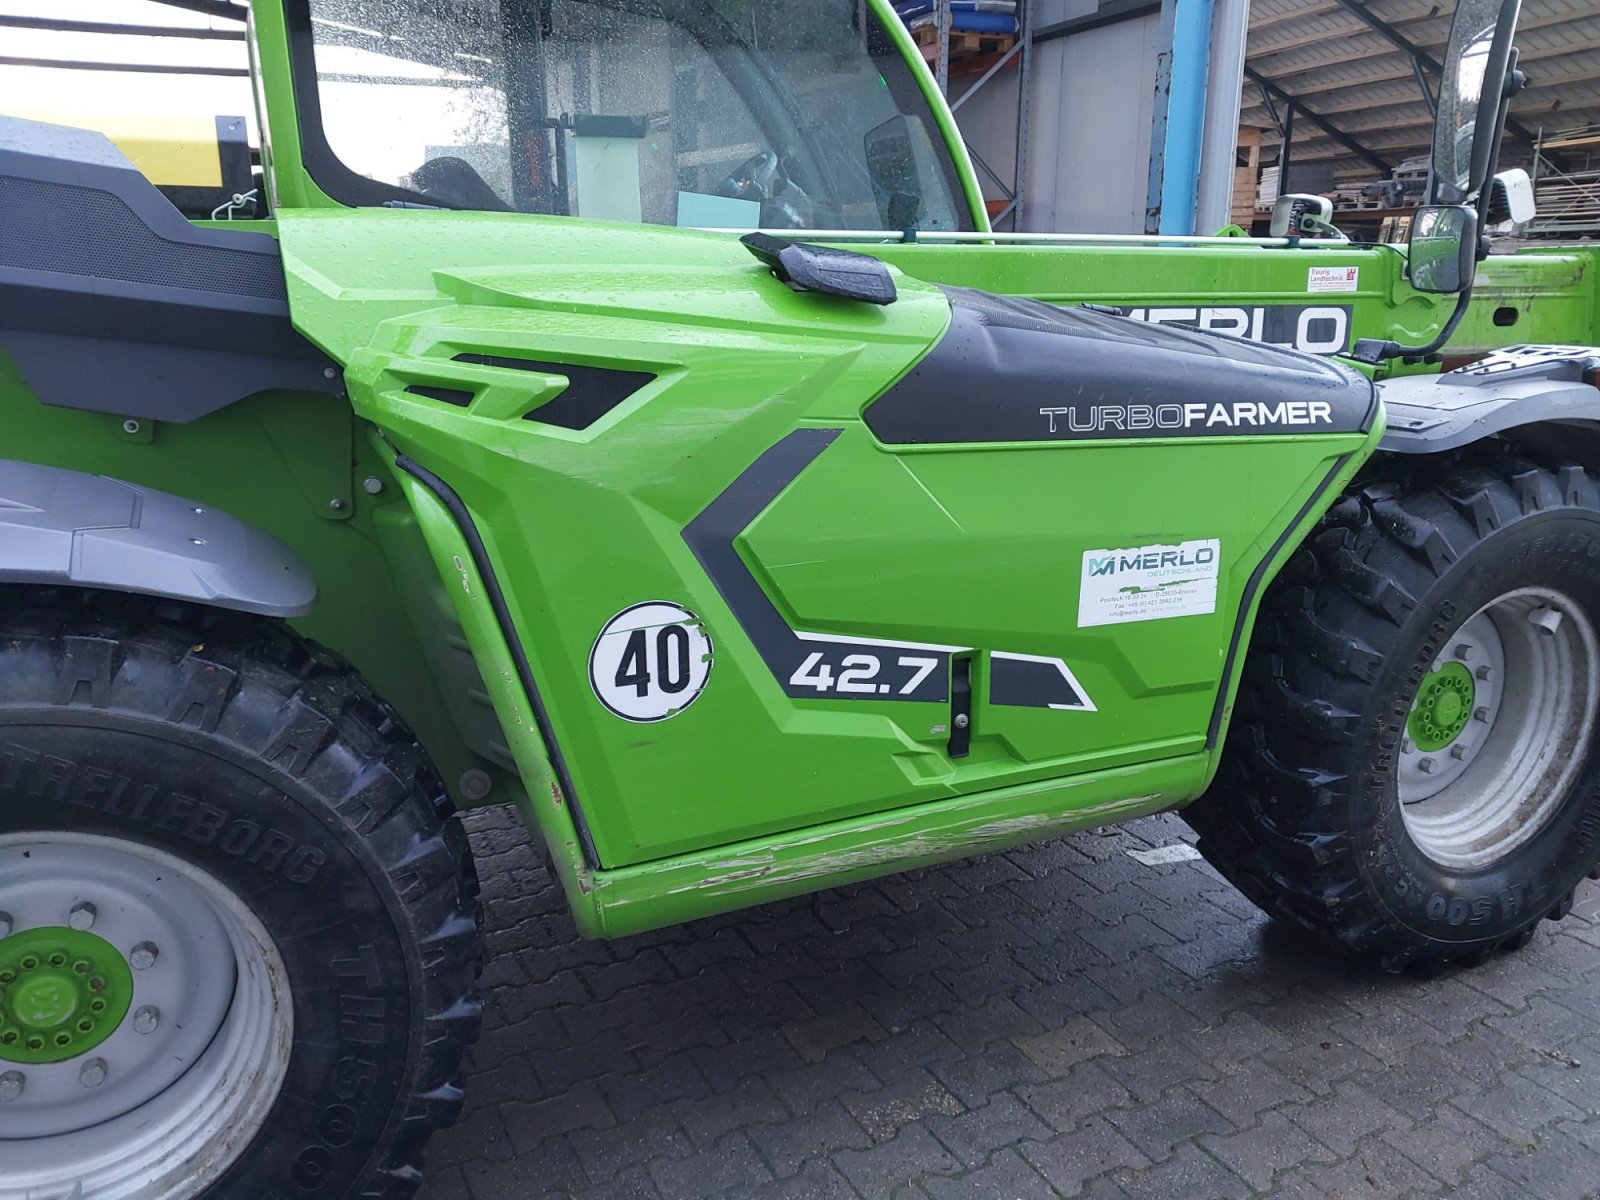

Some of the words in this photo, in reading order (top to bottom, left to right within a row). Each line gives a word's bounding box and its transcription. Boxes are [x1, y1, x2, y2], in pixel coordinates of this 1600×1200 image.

[1039, 401, 1333, 433] TURBOFARMER
[1119, 547, 1214, 572] MERLO
[1146, 565, 1213, 578] DEUTSCHLAND
[613, 624, 692, 698] 40
[788, 651, 939, 696] 42.7
[2, 741, 327, 884] TRELLEBORG
